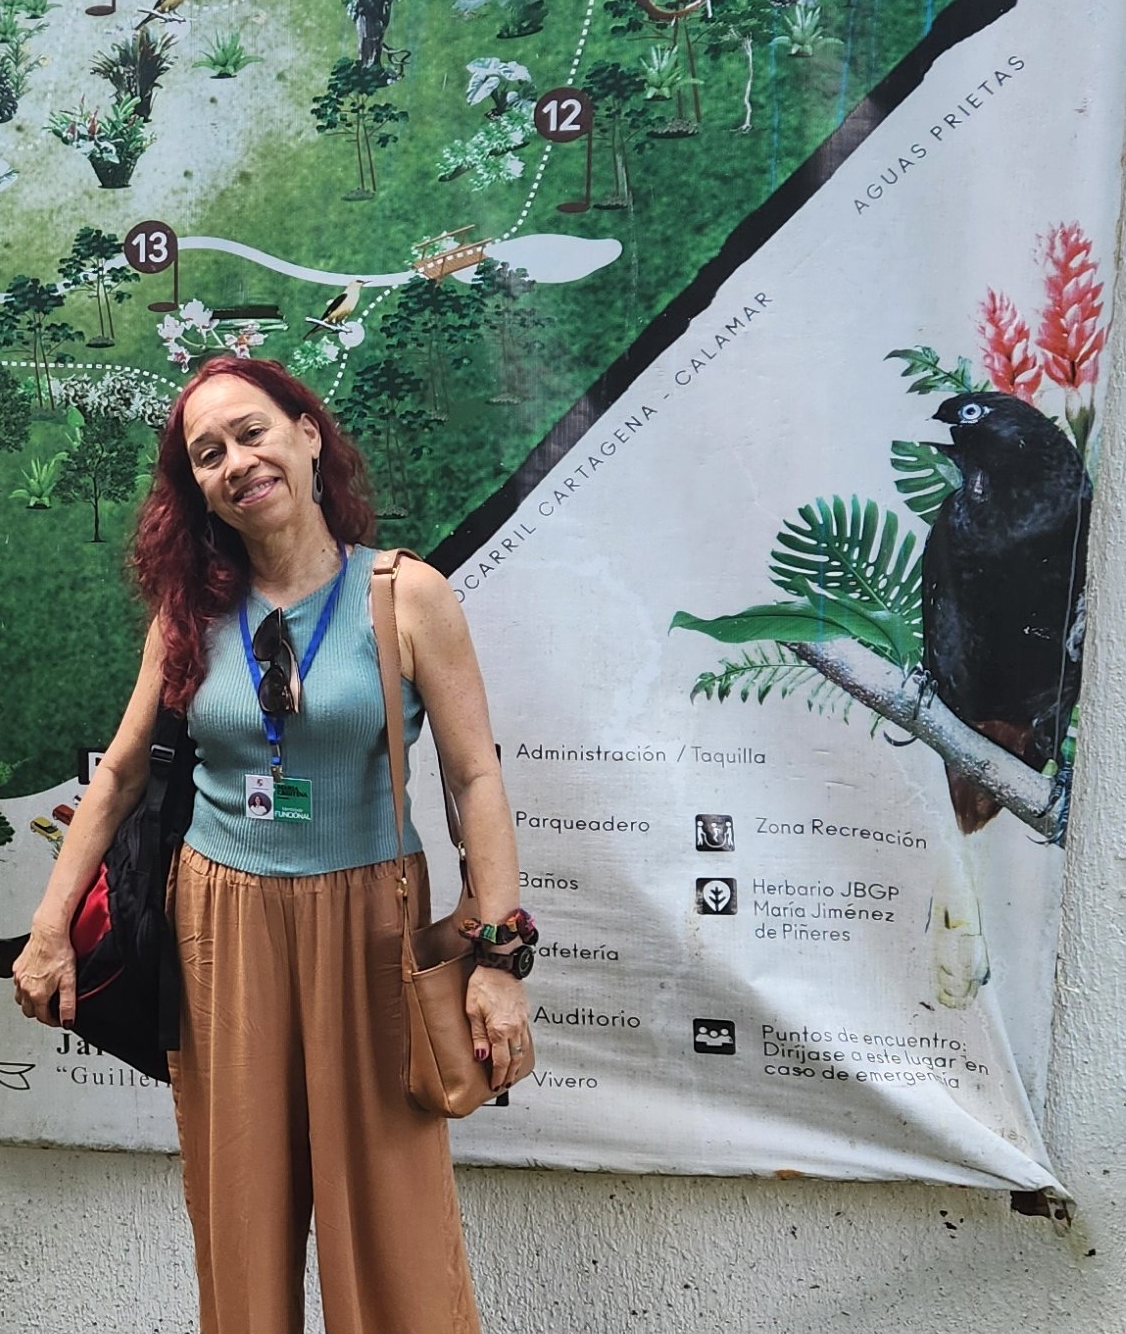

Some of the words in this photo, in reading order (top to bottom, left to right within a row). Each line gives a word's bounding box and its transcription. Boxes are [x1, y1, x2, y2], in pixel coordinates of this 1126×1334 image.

[542, 99, 582, 132] 12
[853, 143, 927, 215] AGUAS
[930, 54, 1025, 143] PRIETAS
[131, 232, 168, 264] 13
[538, 404, 658, 517] CARTAGENA
[674, 291, 773, 386] CALAMAR
[516, 743, 666, 762] Administración
[676, 745, 686, 763] /
[691, 746, 766, 768] Taquilla
[516, 811, 650, 834] Parqueadero
[755, 817, 804, 835] Zona
[811, 818, 927, 849] Recreación
[519, 871, 579, 890] Baños
[753, 878, 835, 897] Herbario
[840, 881, 899, 901] JBGP
[754, 900, 805, 918] María
[811, 902, 895, 923] Jiménez
[755, 923, 777, 939] de
[782, 923, 851, 942] Piñeres
[533, 941, 619, 960] afetería
[534, 1006, 641, 1028] Auditorio
[762, 1024, 833, 1043] Puntos
[838, 1027, 859, 1043] de
[863, 1032, 967, 1052] encuentro:
[763, 1041, 845, 1064] Diríjase
[851, 1051, 862, 1061] a
[867, 1049, 902, 1065] este
[905, 1050, 955, 1070] lugar
[965, 1061, 989, 1075] en
[531, 1069, 598, 1088] Vivero
[764, 1064, 816, 1078] caso
[822, 1065, 849, 1081] de
